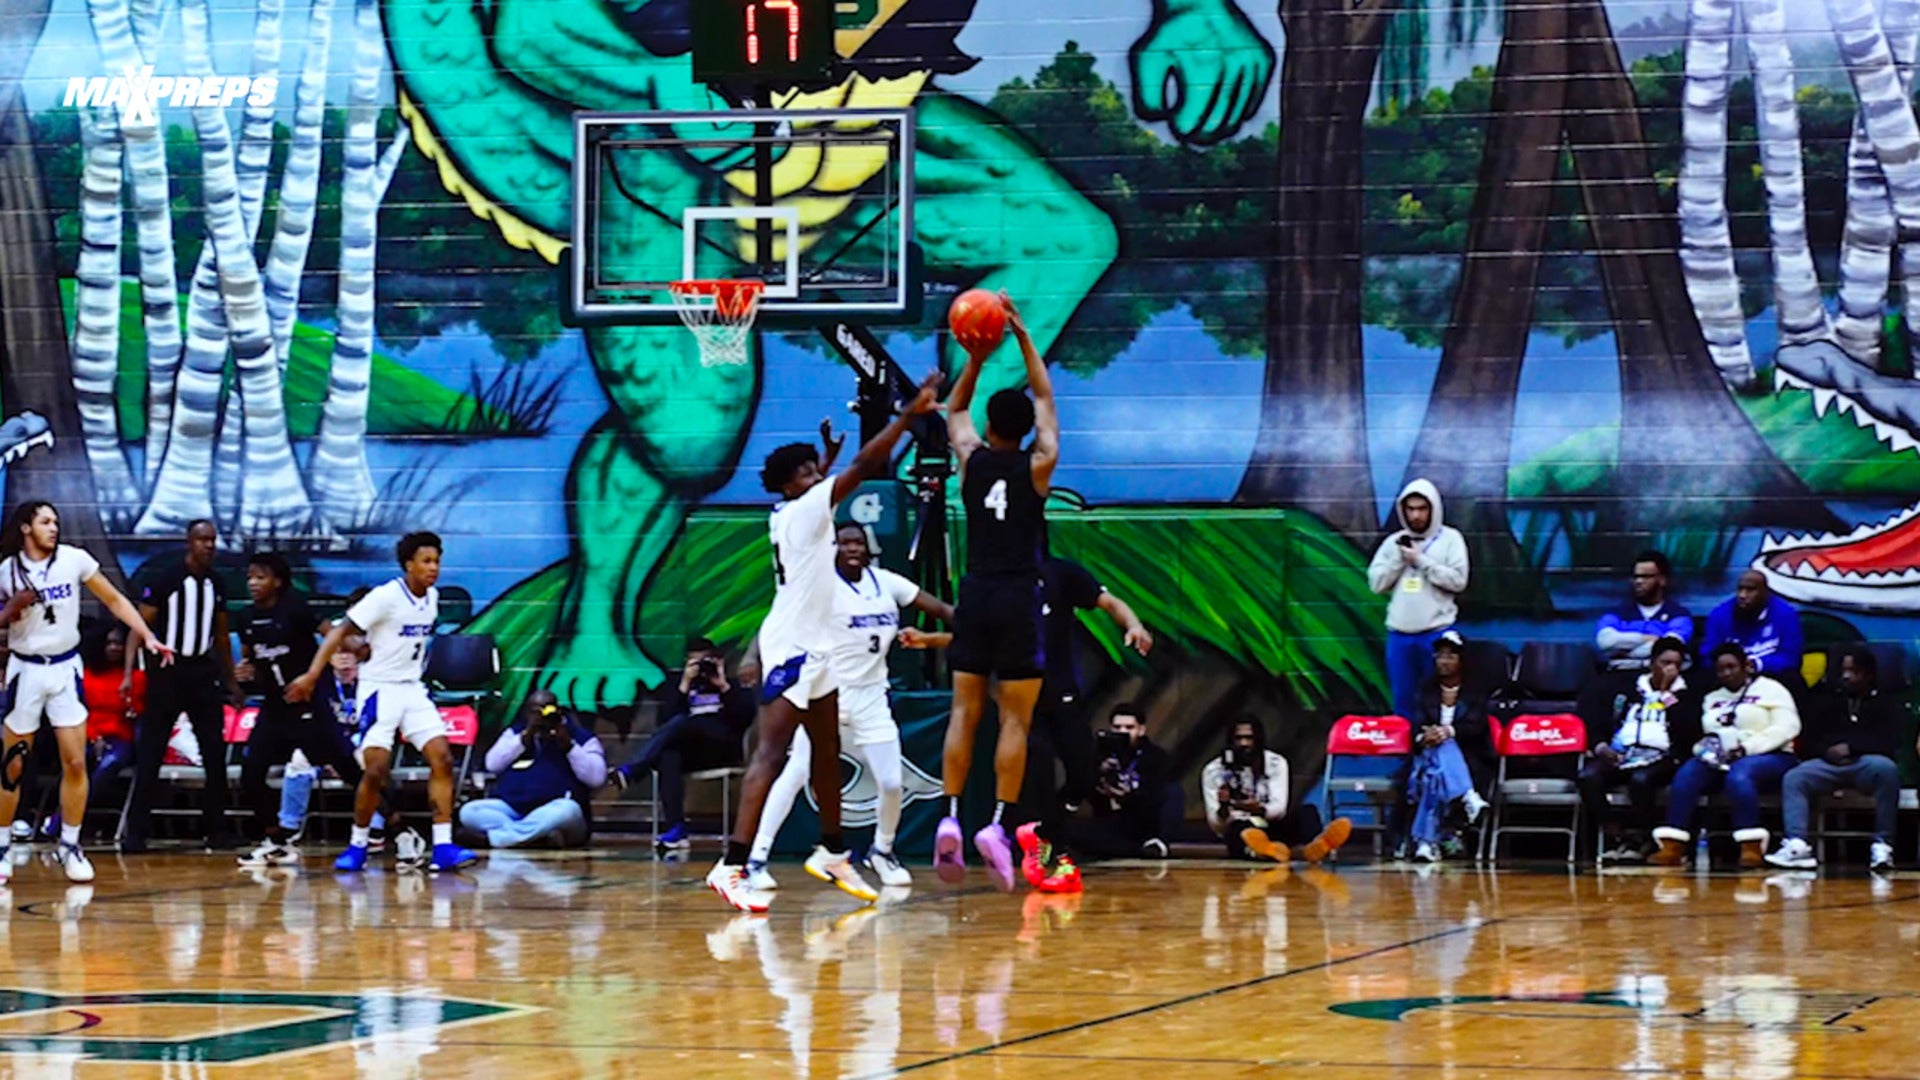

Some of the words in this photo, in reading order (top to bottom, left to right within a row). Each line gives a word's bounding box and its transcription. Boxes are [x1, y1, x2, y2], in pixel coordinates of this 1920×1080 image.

[746, 0, 800, 64] 17
[984, 479, 1008, 521] 4
[43, 604, 57, 625] 4
[868, 634, 881, 654] 3
[271, 663, 286, 686] 1
